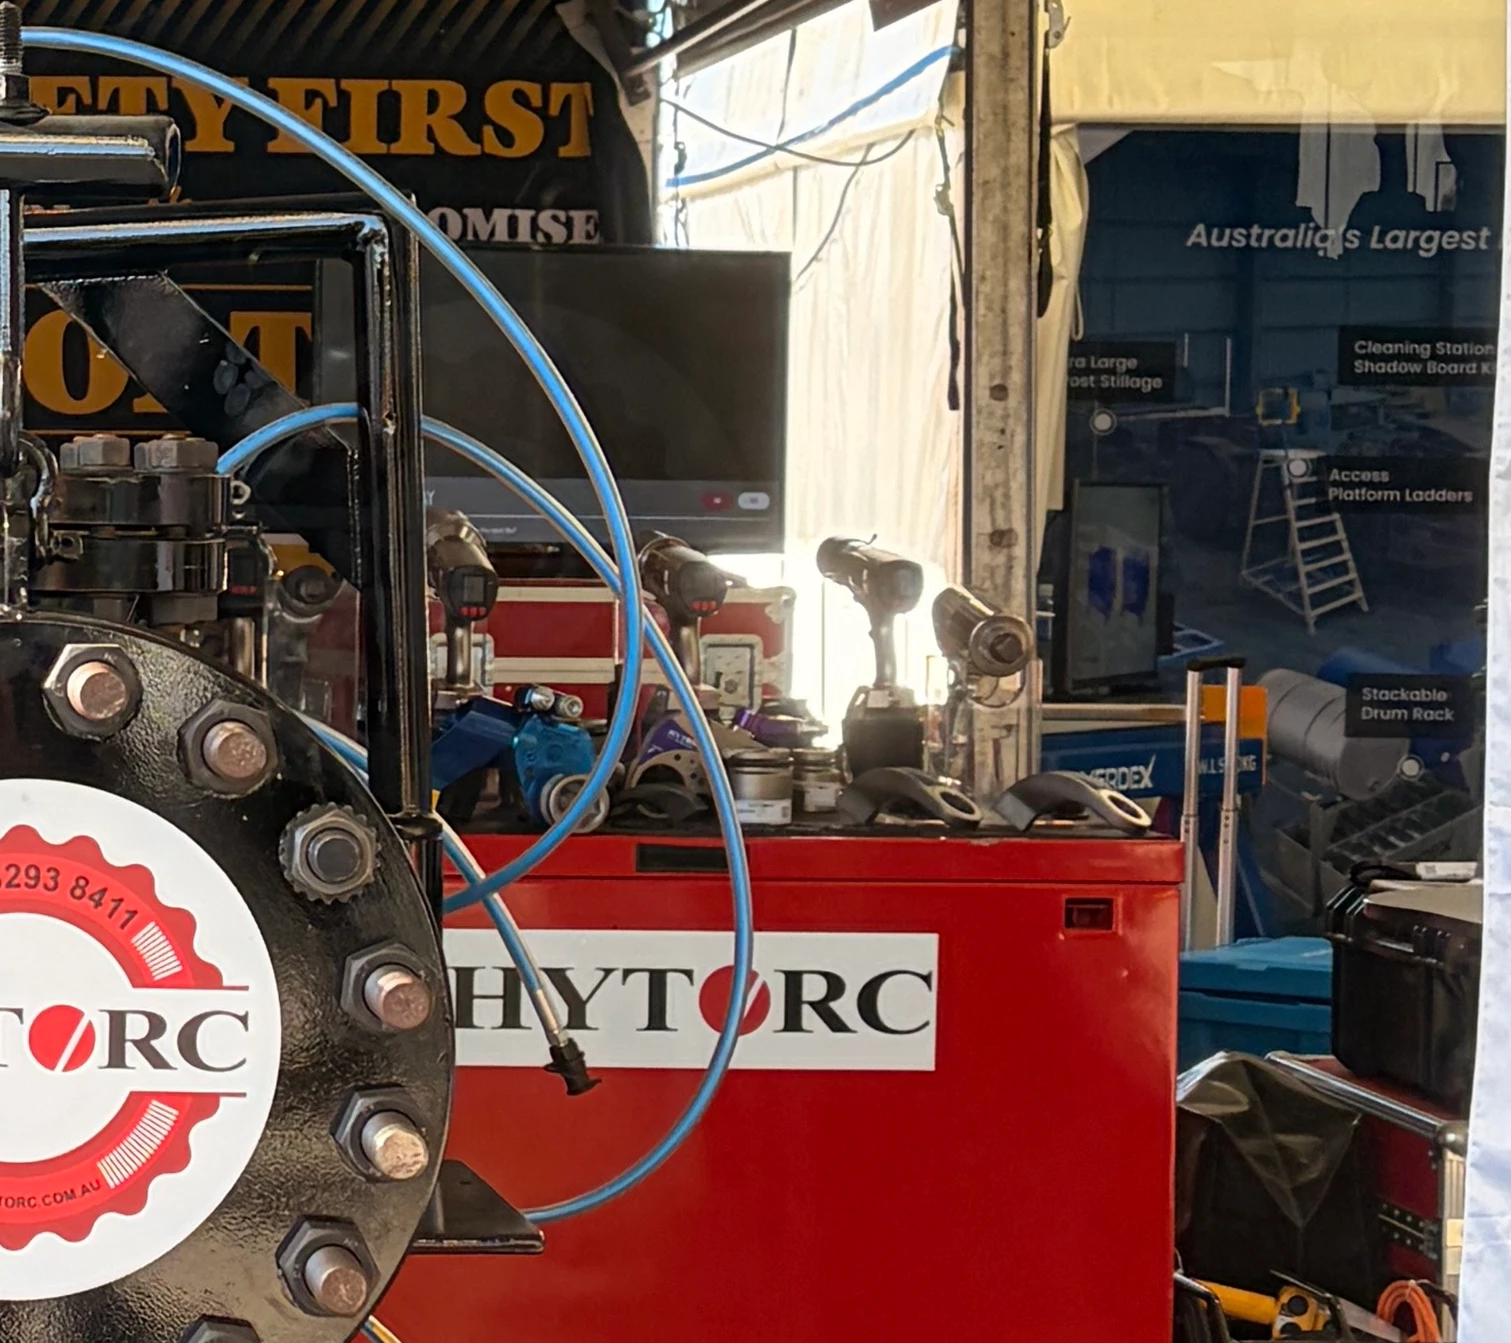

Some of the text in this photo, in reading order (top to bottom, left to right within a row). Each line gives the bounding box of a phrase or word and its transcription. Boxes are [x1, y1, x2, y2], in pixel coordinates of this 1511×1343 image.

[267, 77, 593, 157] FIRST
[1370, 225, 1490, 257] Largest
[1354, 340, 1431, 359] Cleaning
[1090, 356, 1138, 372] Large
[1354, 360, 1422, 373] Shadow
[1426, 361, 1476, 374] Board
[1068, 375, 1163, 393] ost Stillage
[1329, 469, 1390, 482] Access
[1329, 487, 1473, 502] Platform Ladders
[1362, 687, 1448, 702] Stackable
[1361, 707, 1455, 721] Drum Rack
[70, 875, 138, 930] 8411
